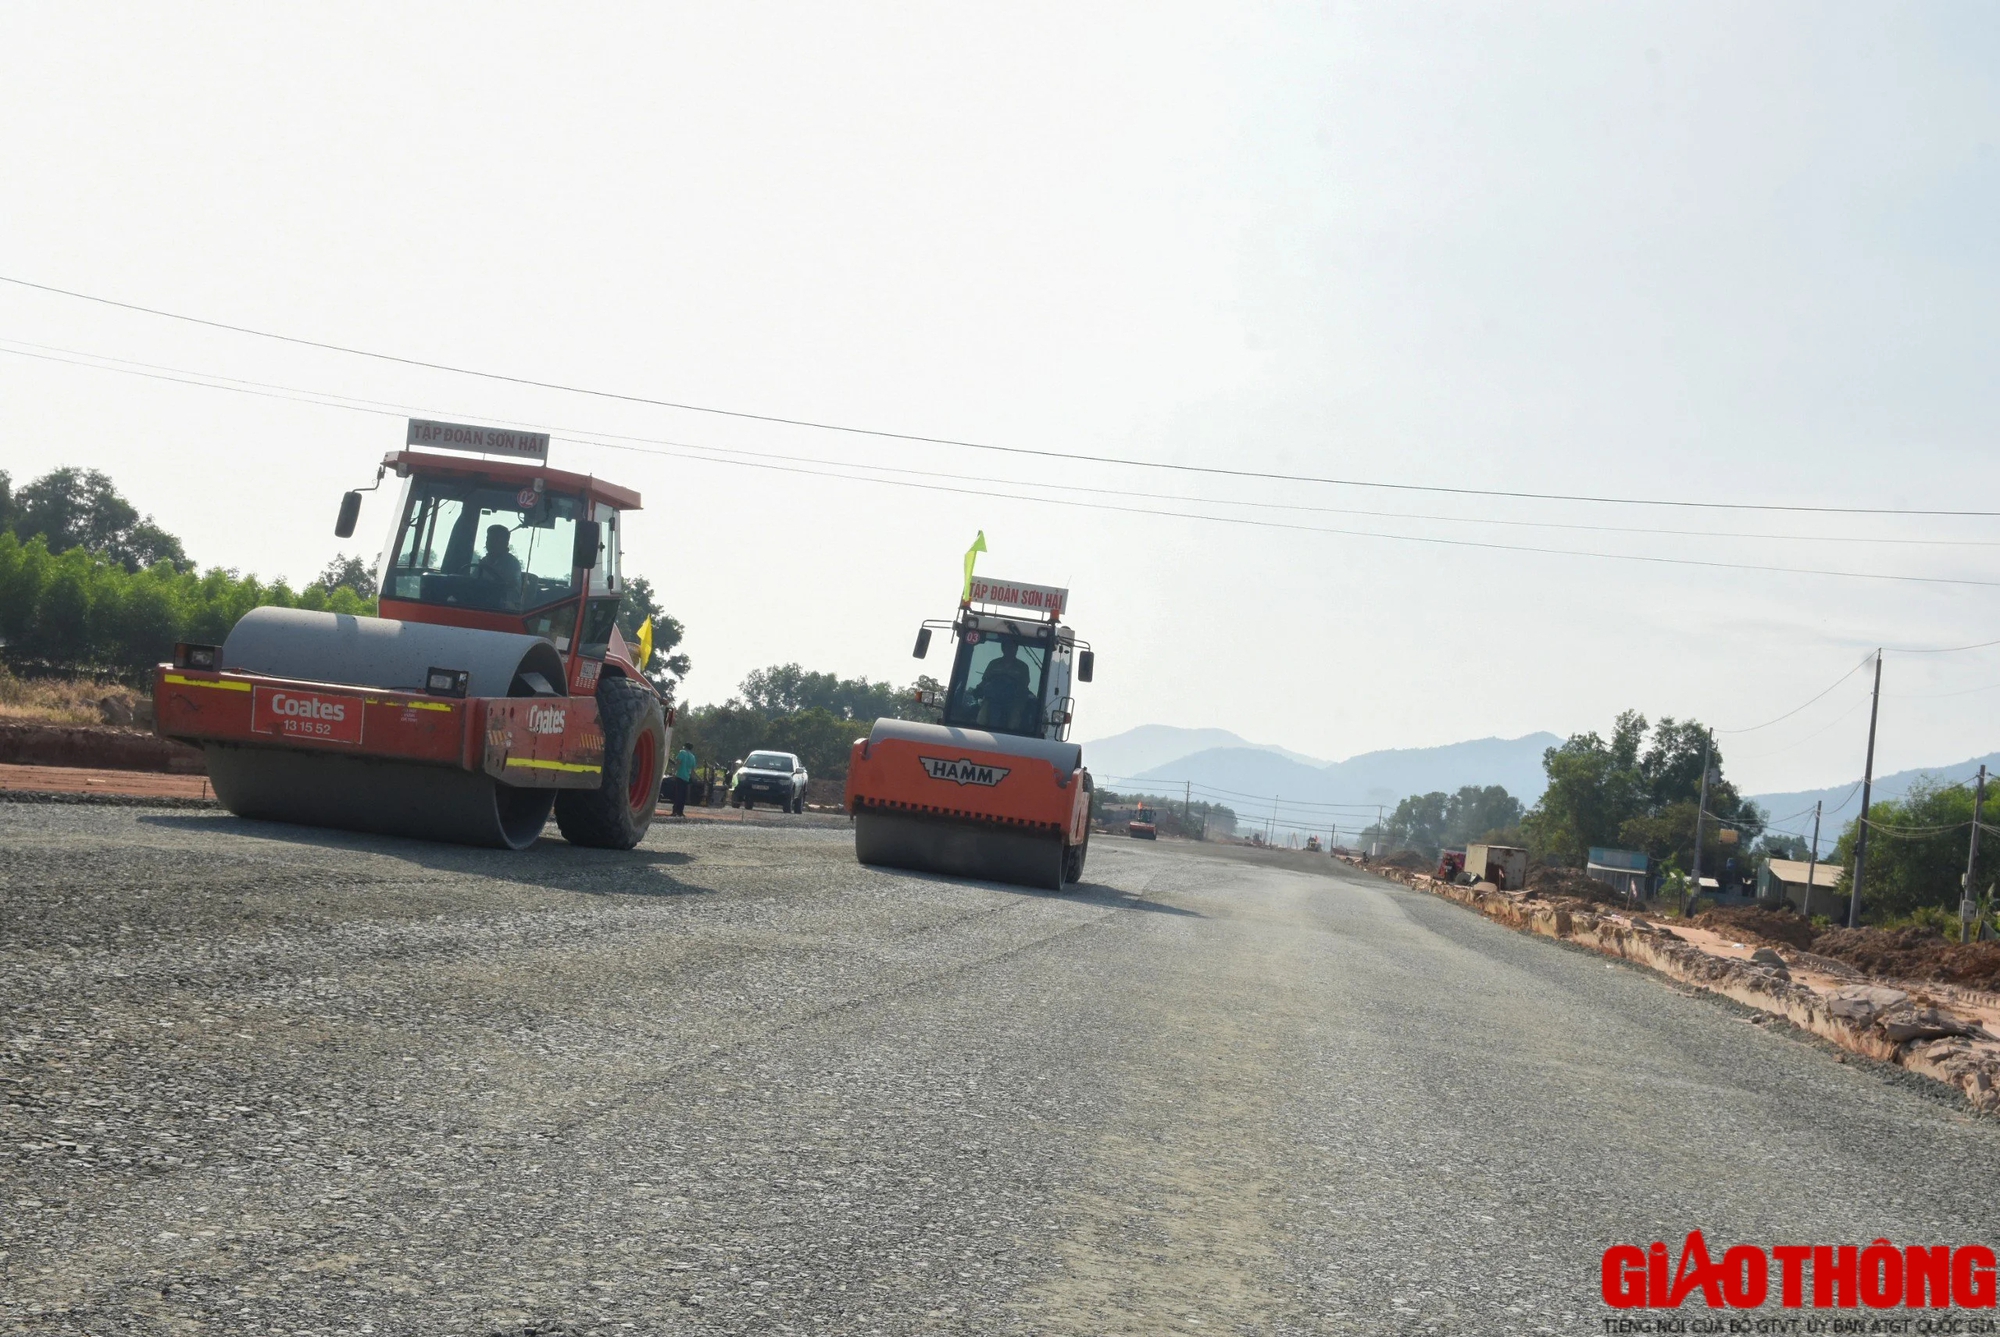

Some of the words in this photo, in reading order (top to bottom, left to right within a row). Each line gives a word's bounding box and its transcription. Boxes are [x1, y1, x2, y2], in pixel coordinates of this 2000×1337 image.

[413, 423, 442, 441] TẬP
[444, 427, 483, 446] ĐOÀN
[486, 431, 515, 449] SƠN
[518, 433, 544, 453] HẢI
[519, 491, 535, 506] 02
[969, 580, 989, 602] TẬP
[990, 585, 1020, 604] ĐOÀN
[1021, 590, 1043, 607] SƠN
[1044, 589, 1063, 610] HẢI
[966, 632, 979, 643] 03
[272, 693, 345, 722] Coates
[528, 704, 566, 735] Coates
[284, 720, 297, 731] 13
[300, 721, 313, 733] 15
[315, 723, 332, 735] 52
[932, 761, 994, 784] HAMM
